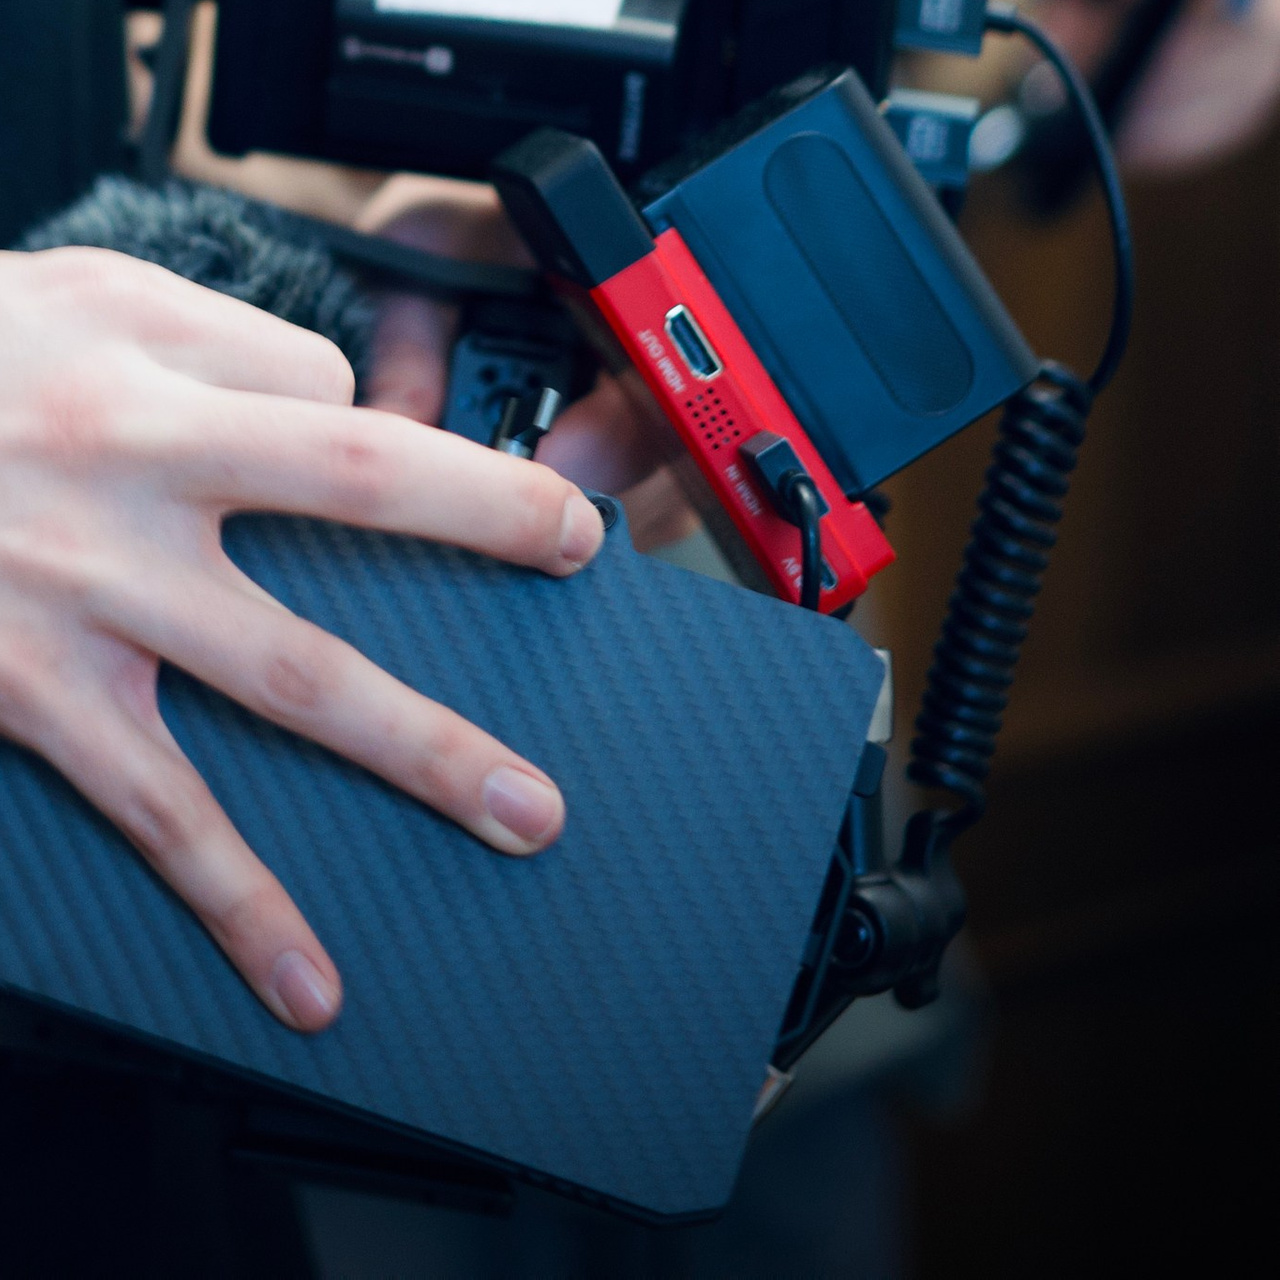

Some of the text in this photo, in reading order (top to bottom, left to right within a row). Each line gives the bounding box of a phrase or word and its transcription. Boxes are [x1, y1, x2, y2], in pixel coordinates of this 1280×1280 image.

[637, 327, 686, 394] HDMI OUT
[724, 464, 763, 517] HDMI IN
